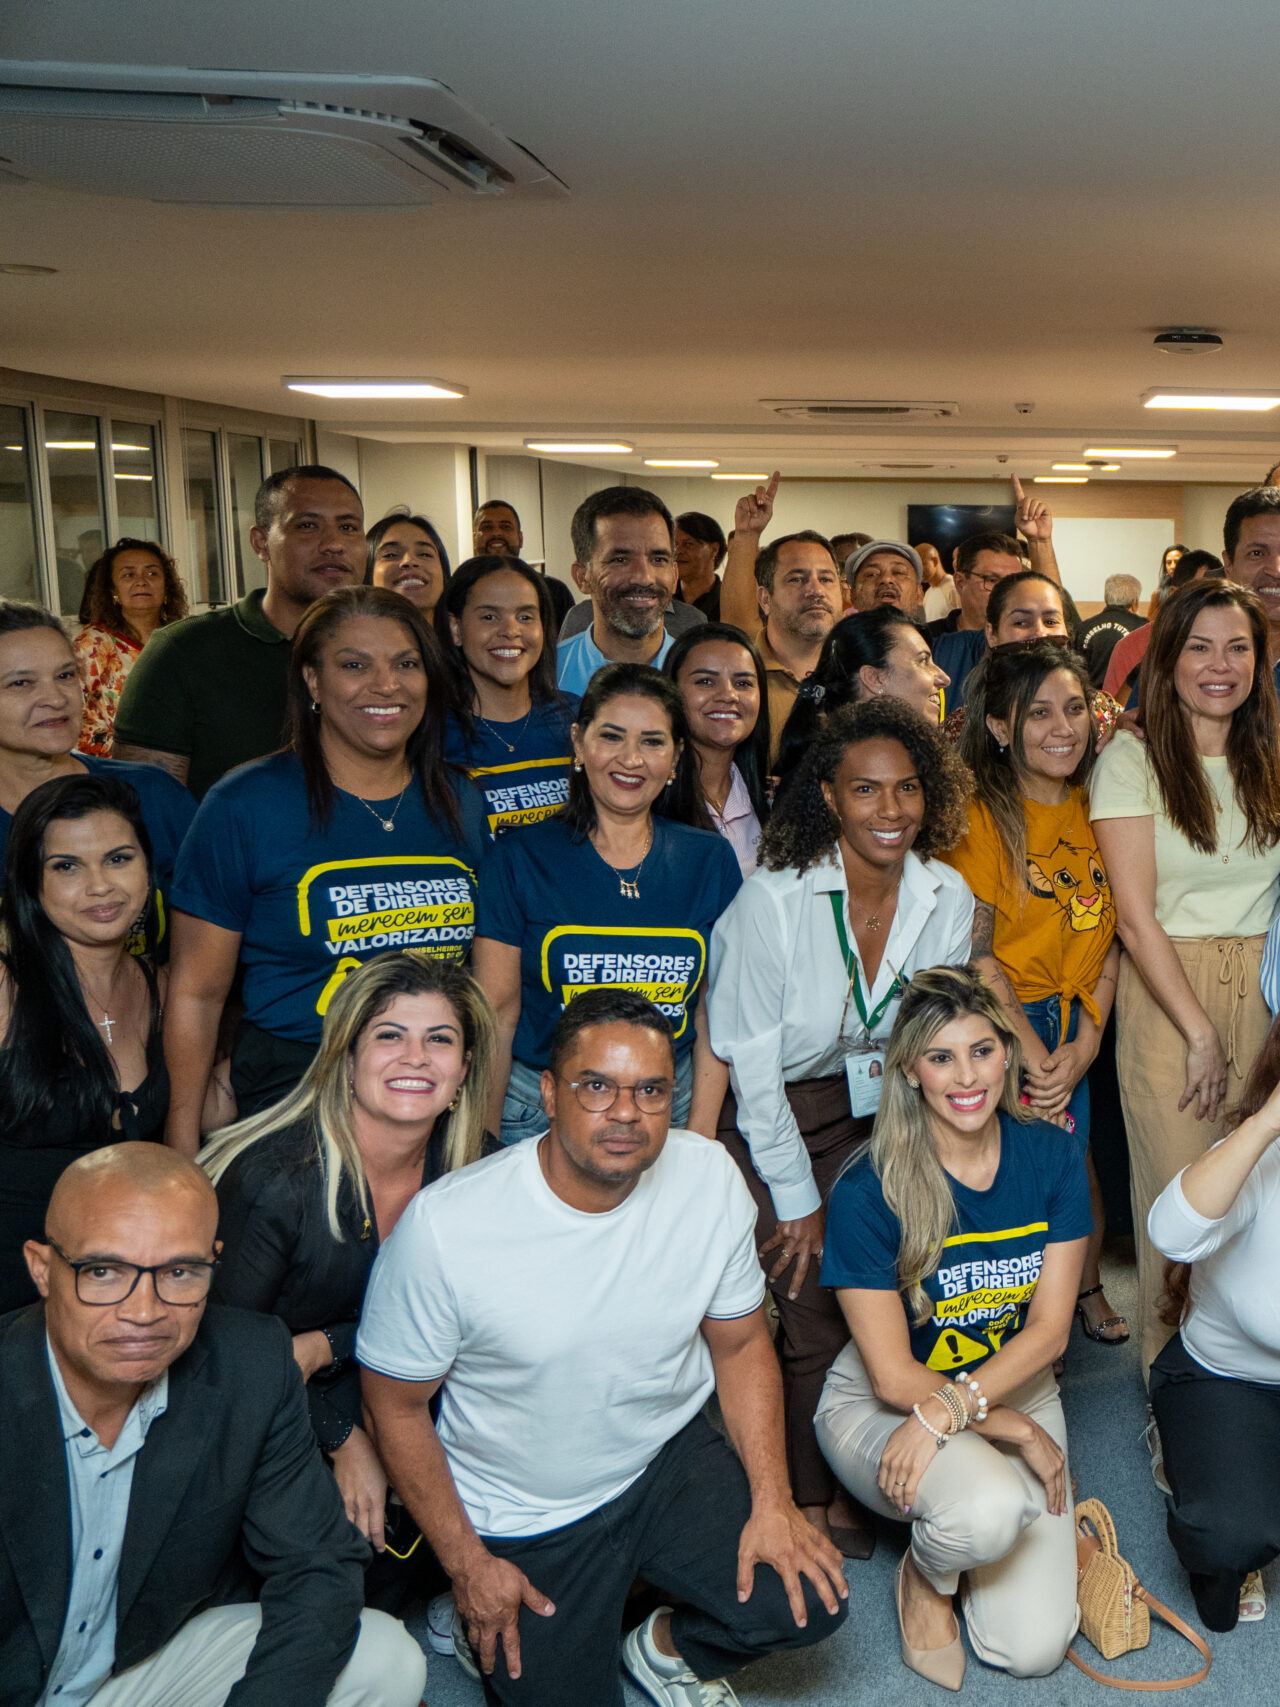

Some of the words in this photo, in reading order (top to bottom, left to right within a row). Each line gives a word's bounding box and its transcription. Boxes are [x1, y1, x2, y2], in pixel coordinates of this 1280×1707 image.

[484, 777, 570, 803] DEFENSOR
[493, 798, 519, 814] DE
[520, 789, 570, 810] DIREIT
[497, 808, 557, 825] merece
[328, 877, 470, 903] DEFENSORES
[336, 901, 369, 917] DE
[374, 890, 472, 911] DIREITOS
[338, 911, 438, 937] merecem
[443, 905, 472, 921] ser
[563, 953, 696, 971] DEFENSORES
[568, 969, 596, 983] DE
[601, 968, 690, 984] DIREITOS
[654, 986, 683, 1001] ser
[937, 1251, 1045, 1285] DEFENSORE
[943, 1279, 968, 1299] DE
[970, 1268, 1040, 1290] DIREITO
[943, 1287, 1021, 1315] merecem
[932, 1302, 1018, 1328] VALORIZA
